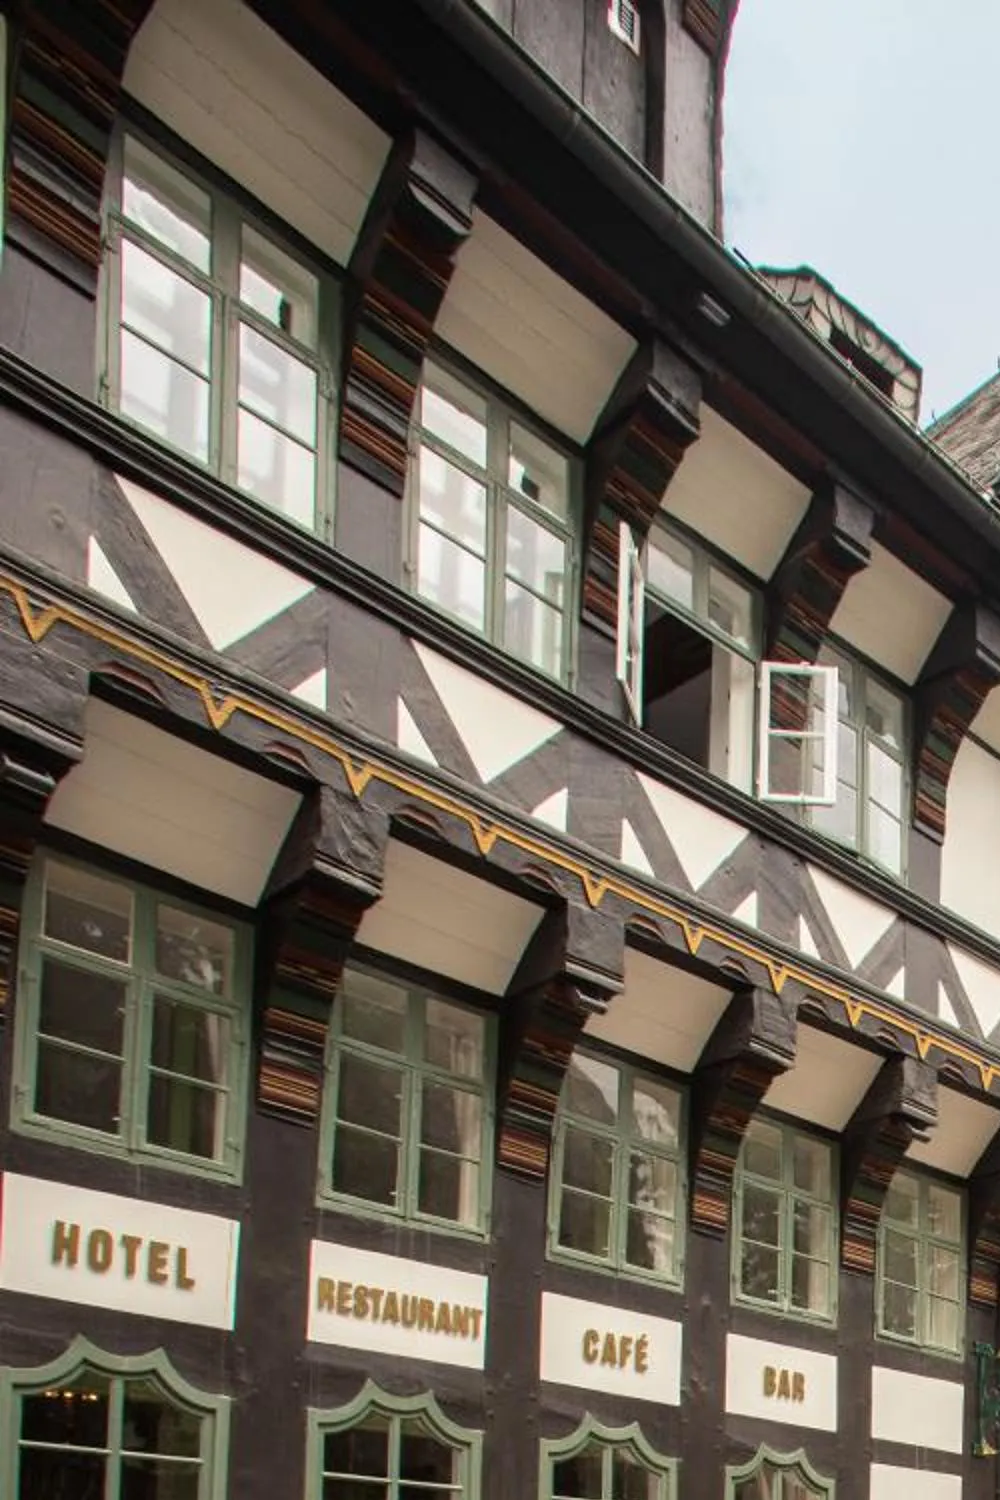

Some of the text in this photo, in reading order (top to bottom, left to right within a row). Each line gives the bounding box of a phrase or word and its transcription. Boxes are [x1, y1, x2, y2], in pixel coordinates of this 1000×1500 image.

[50, 1219, 196, 1292] HOTEL
[316, 1276, 483, 1341] RESTAURANT
[582, 1328, 649, 1375] CAFÉ
[763, 1365, 805, 1403] BAR
